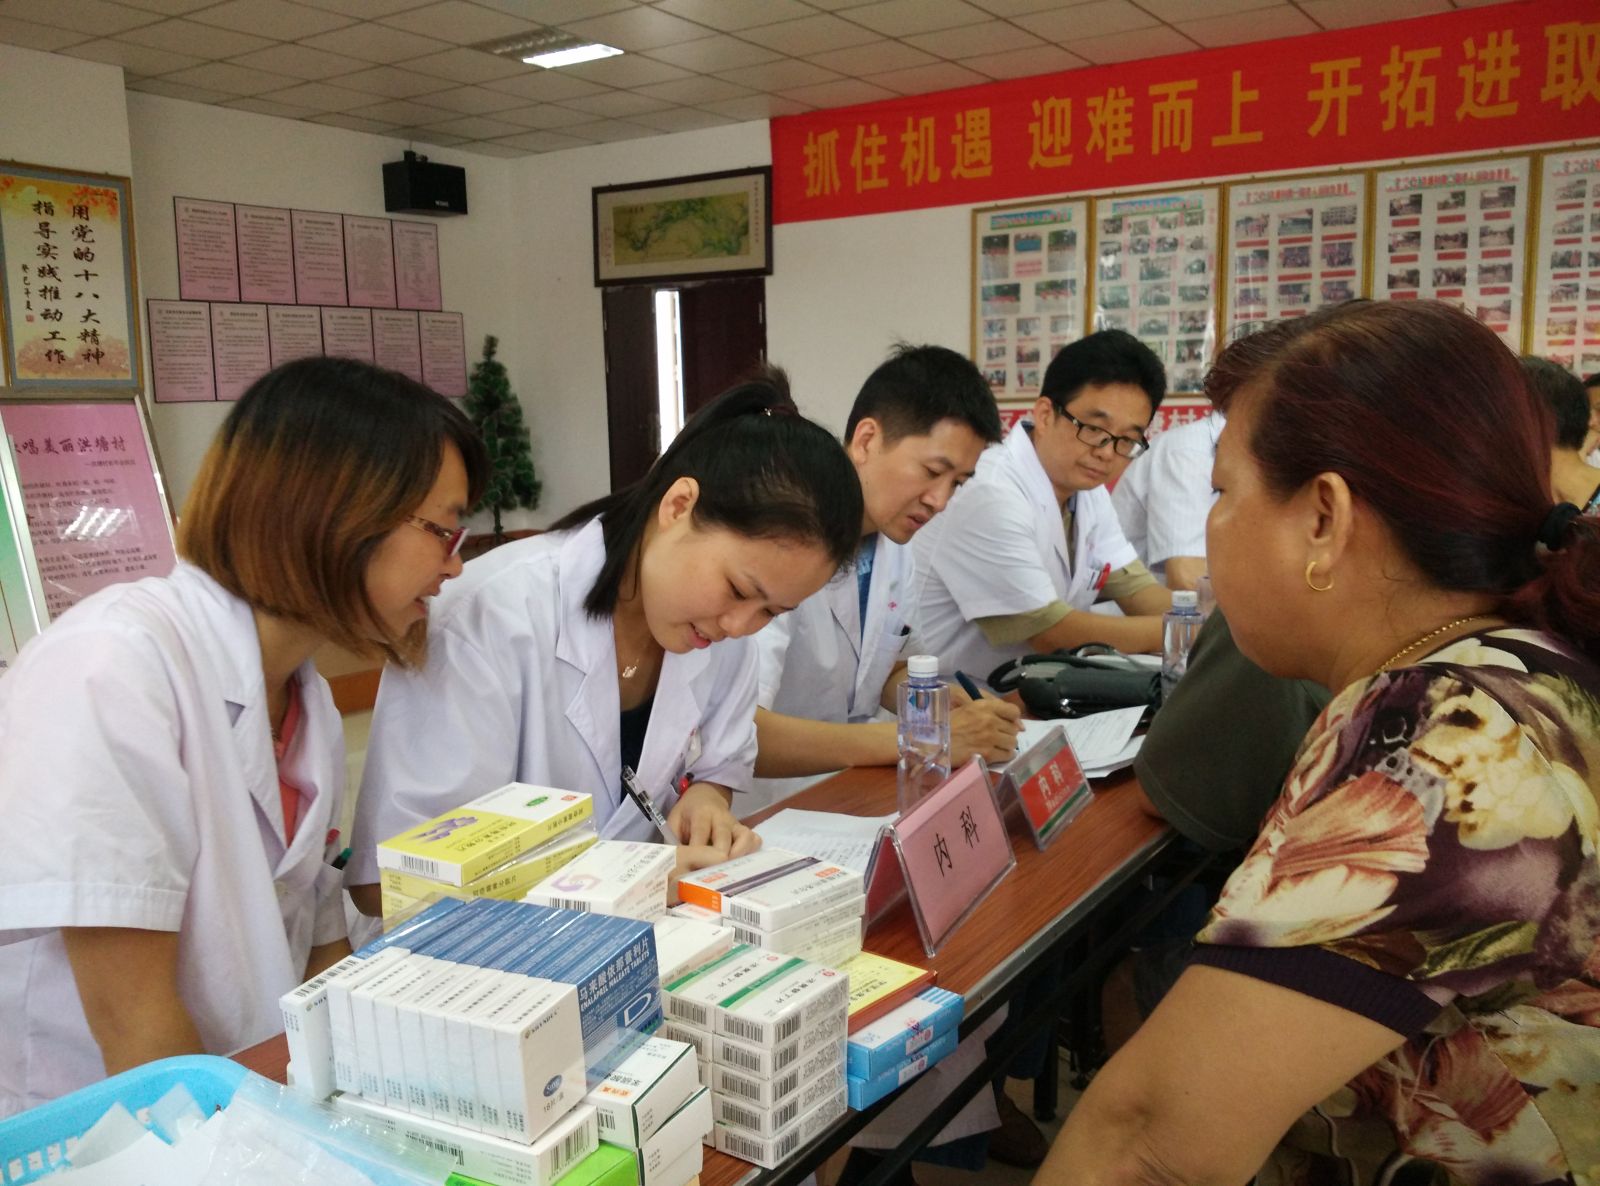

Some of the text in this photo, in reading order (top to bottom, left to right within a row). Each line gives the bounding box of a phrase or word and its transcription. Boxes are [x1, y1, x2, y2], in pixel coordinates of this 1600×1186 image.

[803, 21, 1600, 198] 抓住机遇 迎难而上 开拓进取
[32, 200, 67, 365] 指导实践推动工作
[71, 204, 106, 365] 用党的十八大精神
[933, 805, 980, 877] 内科
[580, 936, 649, 1001] 马来酸依那普利片
[581, 950, 650, 1010] ENALAPRIL MALEATE TABLETS
